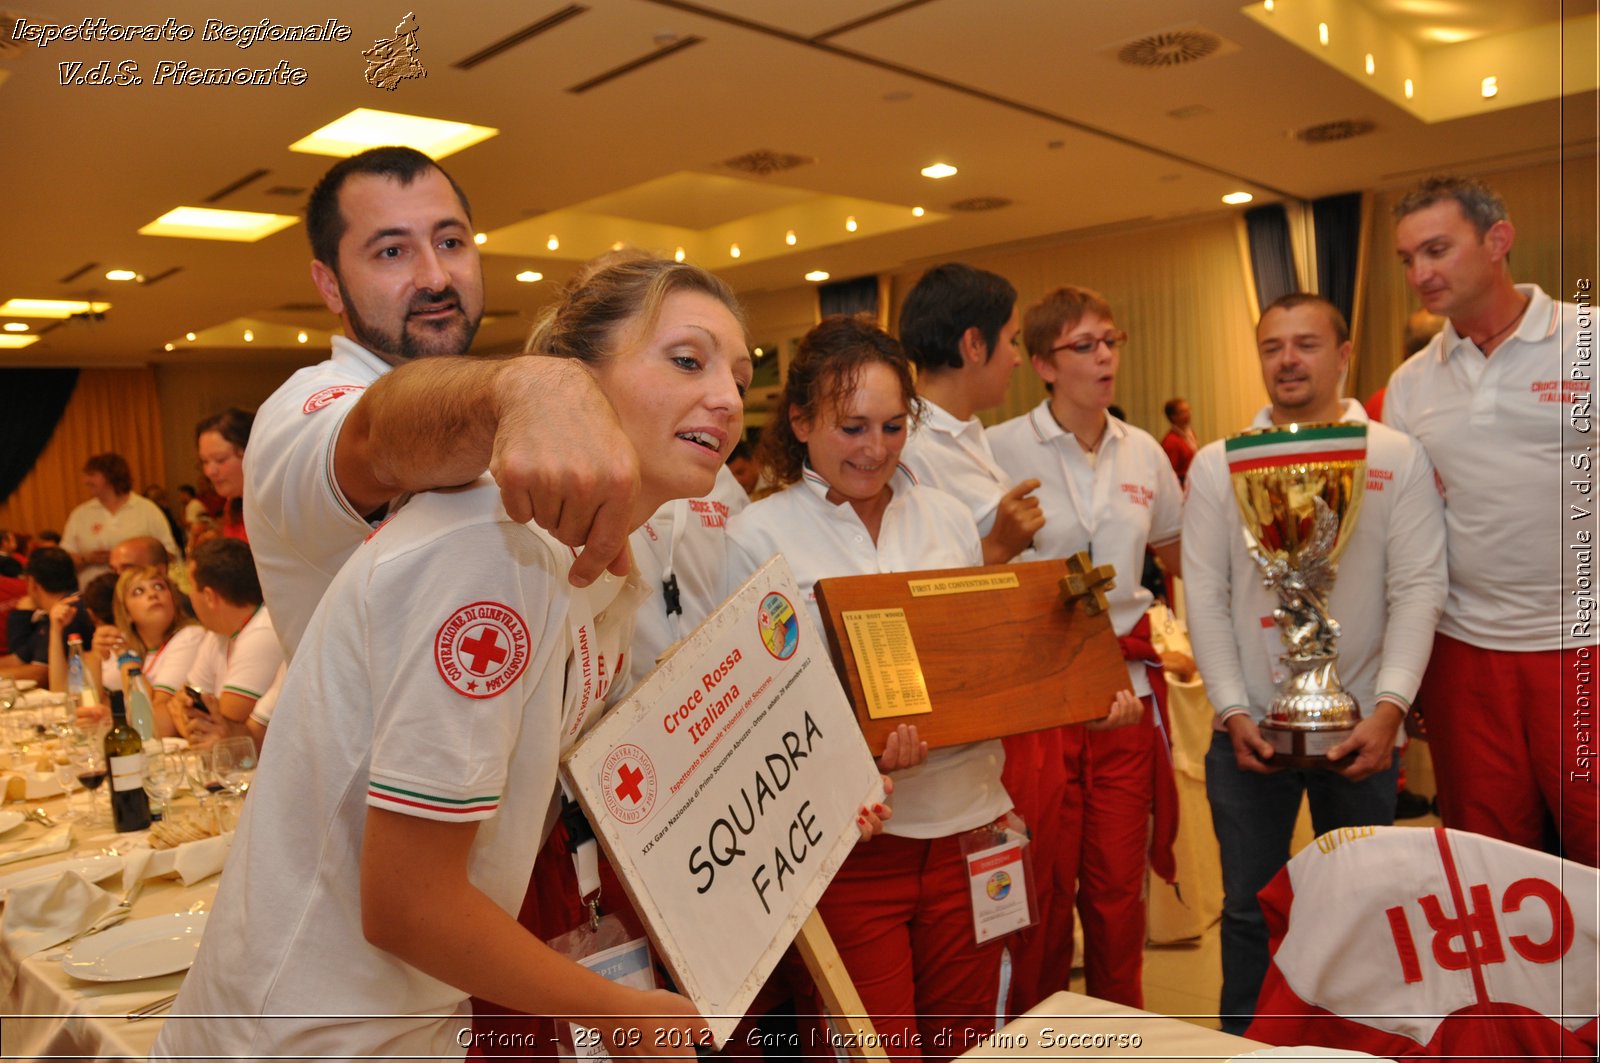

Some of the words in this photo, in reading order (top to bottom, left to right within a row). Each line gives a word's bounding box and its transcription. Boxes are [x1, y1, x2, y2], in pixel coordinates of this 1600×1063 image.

[912, 585, 931, 593] FIRST
[948, 579, 990, 590] CONVENTION
[990, 576, 1015, 585] EUROPE
[464, 609, 477, 622] DI
[478, 607, 518, 633] GINEVRA
[441, 616, 467, 681] CONVENZIONE
[512, 630, 525, 642] 22
[579, 625, 591, 678] ITALIANA
[504, 644, 526, 680] AGOSTO
[485, 676, 505, 692] 1864
[581, 678, 591, 709] ROSSA
[663, 689, 703, 734] Croce
[702, 648, 742, 692] Rossa
[687, 684, 741, 744] Italiana
[669, 759, 700, 794] Ispettorato
[699, 731, 723, 759] Nazionale
[723, 707, 745, 736] Volontari
[744, 696, 753, 709] del
[752, 675, 773, 700] Soccorso
[604, 772, 611, 781] DI
[606, 748, 631, 770] GINEVRA
[639, 754, 655, 786] AGOSTO
[642, 840, 655, 856] XIX
[654, 825, 669, 843] Gara
[668, 795, 695, 828] Nazionale
[694, 787, 700, 798] di
[699, 773, 714, 792] Primo
[713, 750, 735, 775] Soccorso
[733, 728, 752, 751] Abruzzo
[752, 710, 767, 727] Ortona
[767, 694, 780, 711] sabato
[604, 784, 640, 821] CONVENZIONE
[689, 710, 823, 894] SQUADRA
[752, 800, 823, 915] FACE
[1386, 877, 1575, 984] CRI
